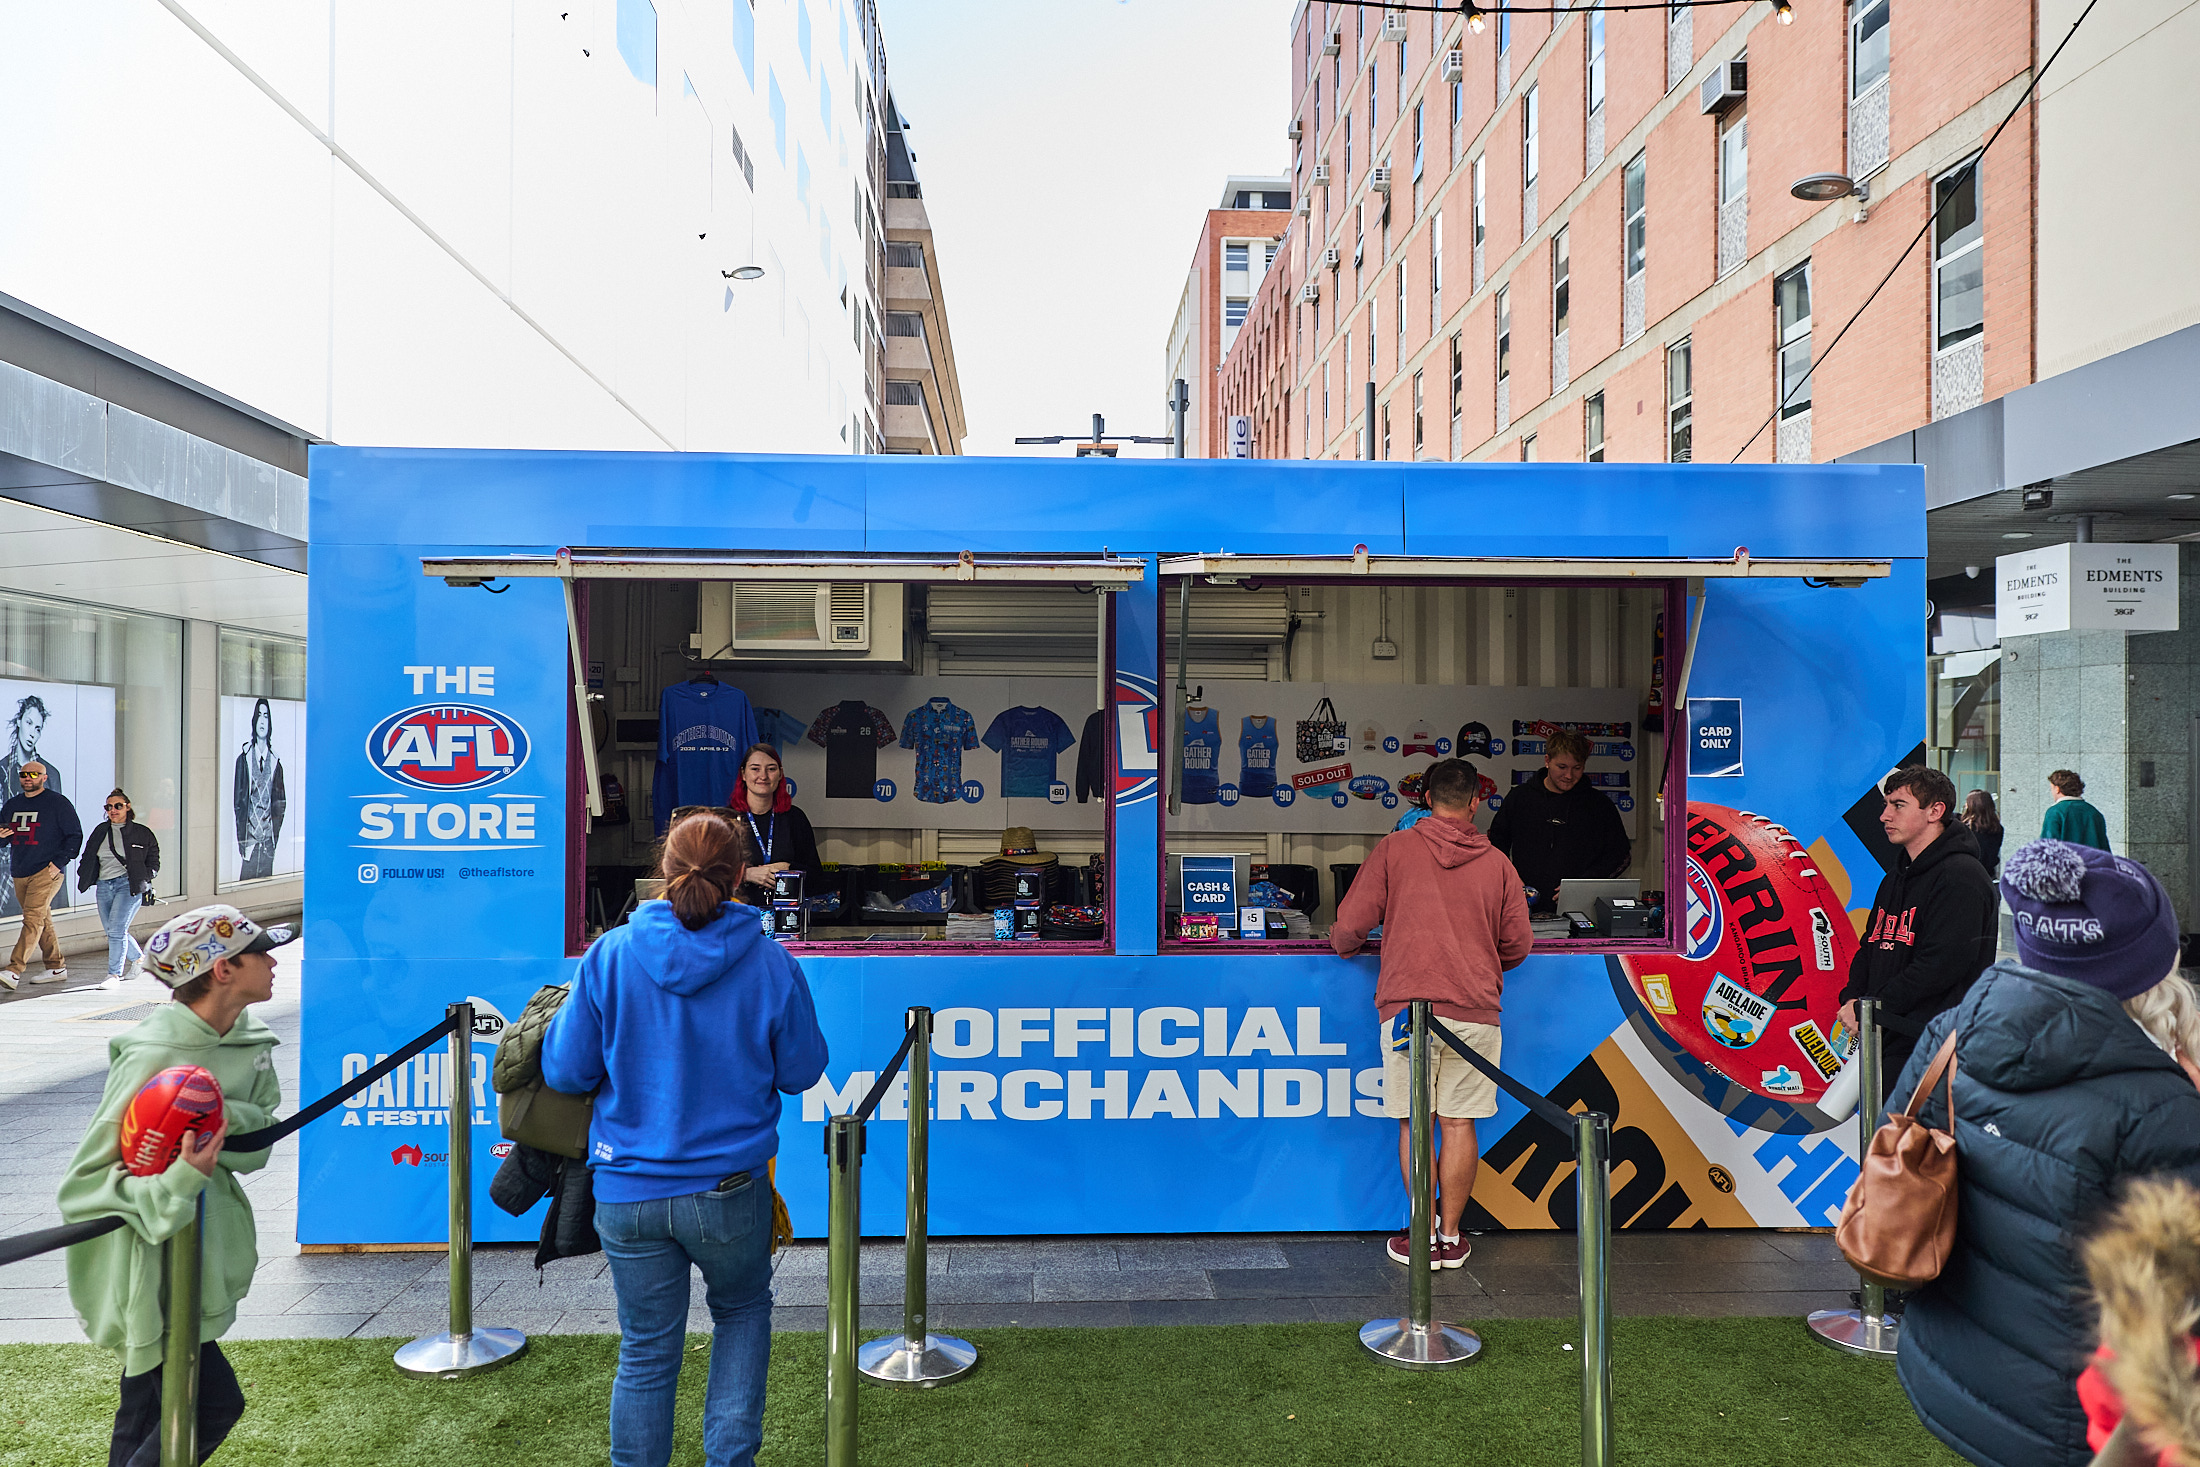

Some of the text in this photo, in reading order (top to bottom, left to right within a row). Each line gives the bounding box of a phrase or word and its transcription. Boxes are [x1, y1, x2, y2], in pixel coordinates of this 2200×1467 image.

[2007, 572, 2058, 592] EDMENTS
[2086, 569, 2163, 583] EDMENTS
[2017, 591, 2047, 601] BUILDING
[2113, 607, 2136, 617] 38GP
[403, 665, 495, 697] THE
[859, 726, 871, 736] 26
[1699, 727, 1732, 736] CARD
[381, 724, 516, 767] AFL
[1337, 741, 1346, 749] $5
[1385, 740, 1397, 750] $45
[1437, 740, 1449, 751] $45
[1491, 743, 1503, 752] $50
[1700, 738, 1731, 749] ONLY
[1183, 746, 1212, 759] GATHER
[1246, 748, 1271, 759] GATHER
[1621, 748, 1633, 758] $35
[1184, 758, 1211, 769] ROUND
[1247, 758, 1270, 768] ROUND
[1297, 768, 1347, 786] SOLD OUT
[876, 784, 893, 797] $70
[964, 785, 979, 798] $70
[1051, 788, 1065, 796] $60
[1218, 789, 1239, 801] $100
[1276, 790, 1292, 802] $90
[1334, 795, 1345, 805] $10
[1384, 796, 1396, 806] $20
[1620, 799, 1632, 808] $35
[358, 803, 535, 840] STORE
[382, 867, 535, 879] FOLLOW US! @theaflstore
[1187, 882, 1231, 892] CASH &
[1192, 893, 1227, 903] CARD
[1687, 811, 1808, 1012] ERRIN
[1247, 913, 1258, 923] $5
[2017, 910, 2104, 945] CATS
[1728, 921, 1746, 965] KANGAROO
[1820, 935, 1831, 966] SOUTH
[1715, 982, 1768, 1020] ADELAIDE
[1727, 1003, 1745, 1016] OVAL
[472, 1018, 501, 1031] AFL
[930, 1006, 1347, 1059] OFFICIAL
[1795, 1023, 1841, 1080] ADELAIDE
[341, 1053, 487, 1109] GATHR
[801, 1068, 1388, 1122] MERCHANDIS
[341, 1111, 361, 1126] A
[492, 1146, 512, 1155] AF
[424, 1153, 449, 1162] SOUT
[1710, 1171, 1731, 1192] AFL
